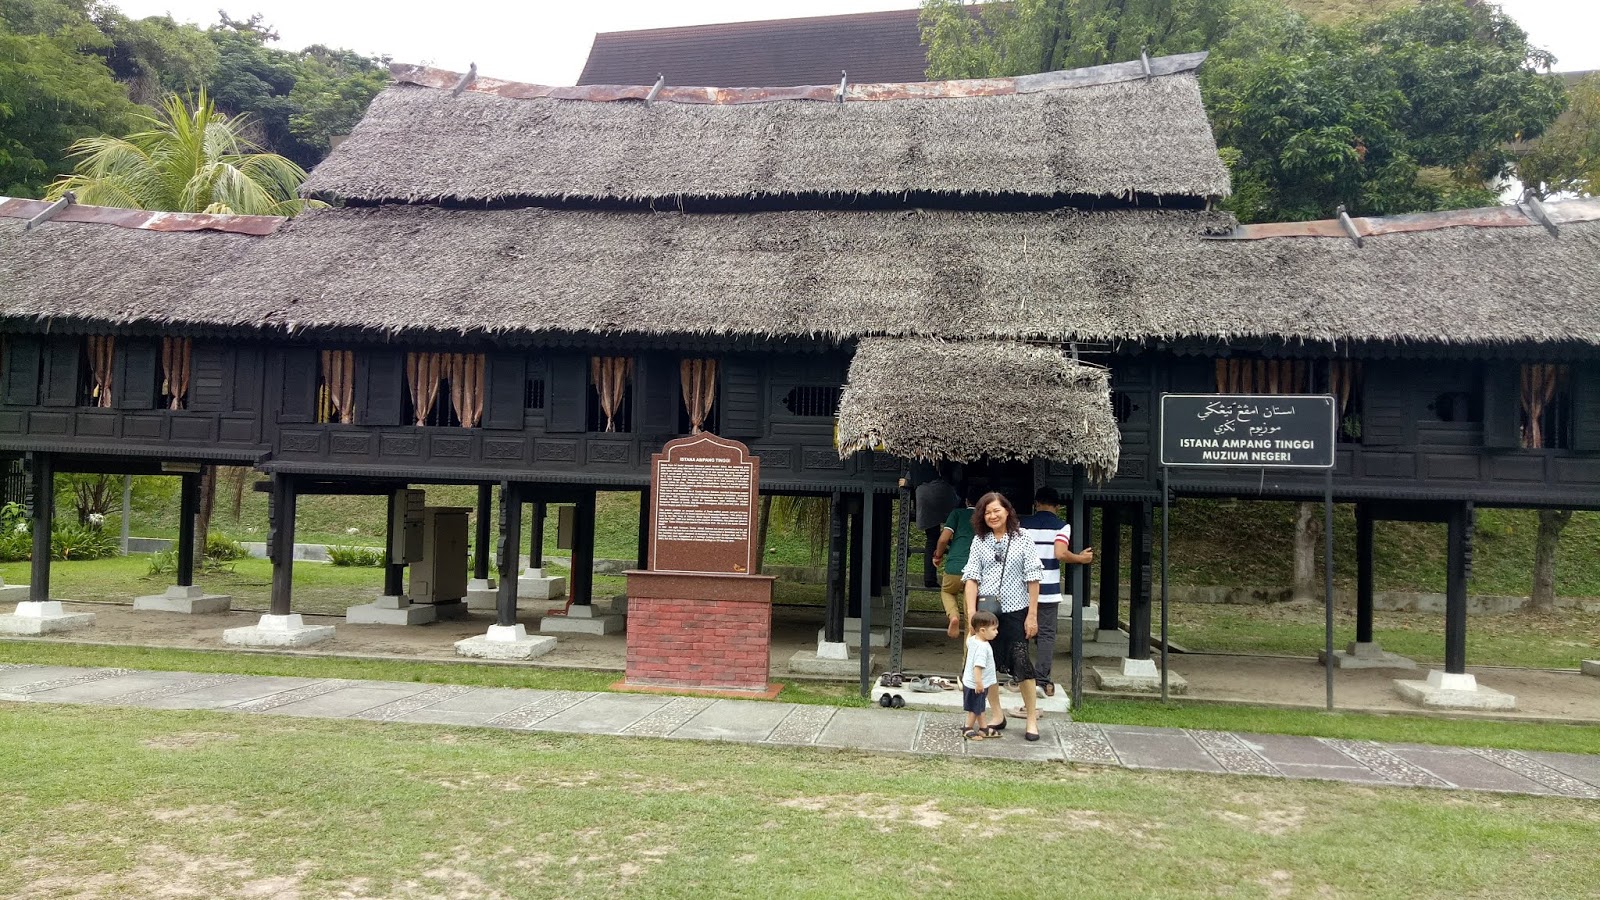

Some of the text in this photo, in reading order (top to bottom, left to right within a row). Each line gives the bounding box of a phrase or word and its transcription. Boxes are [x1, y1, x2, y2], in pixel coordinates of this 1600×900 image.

[1180, 438, 1314, 449] ISTANA AMPANG TINGGI
[1202, 451, 1291, 461] MUZIUM NEGERI
